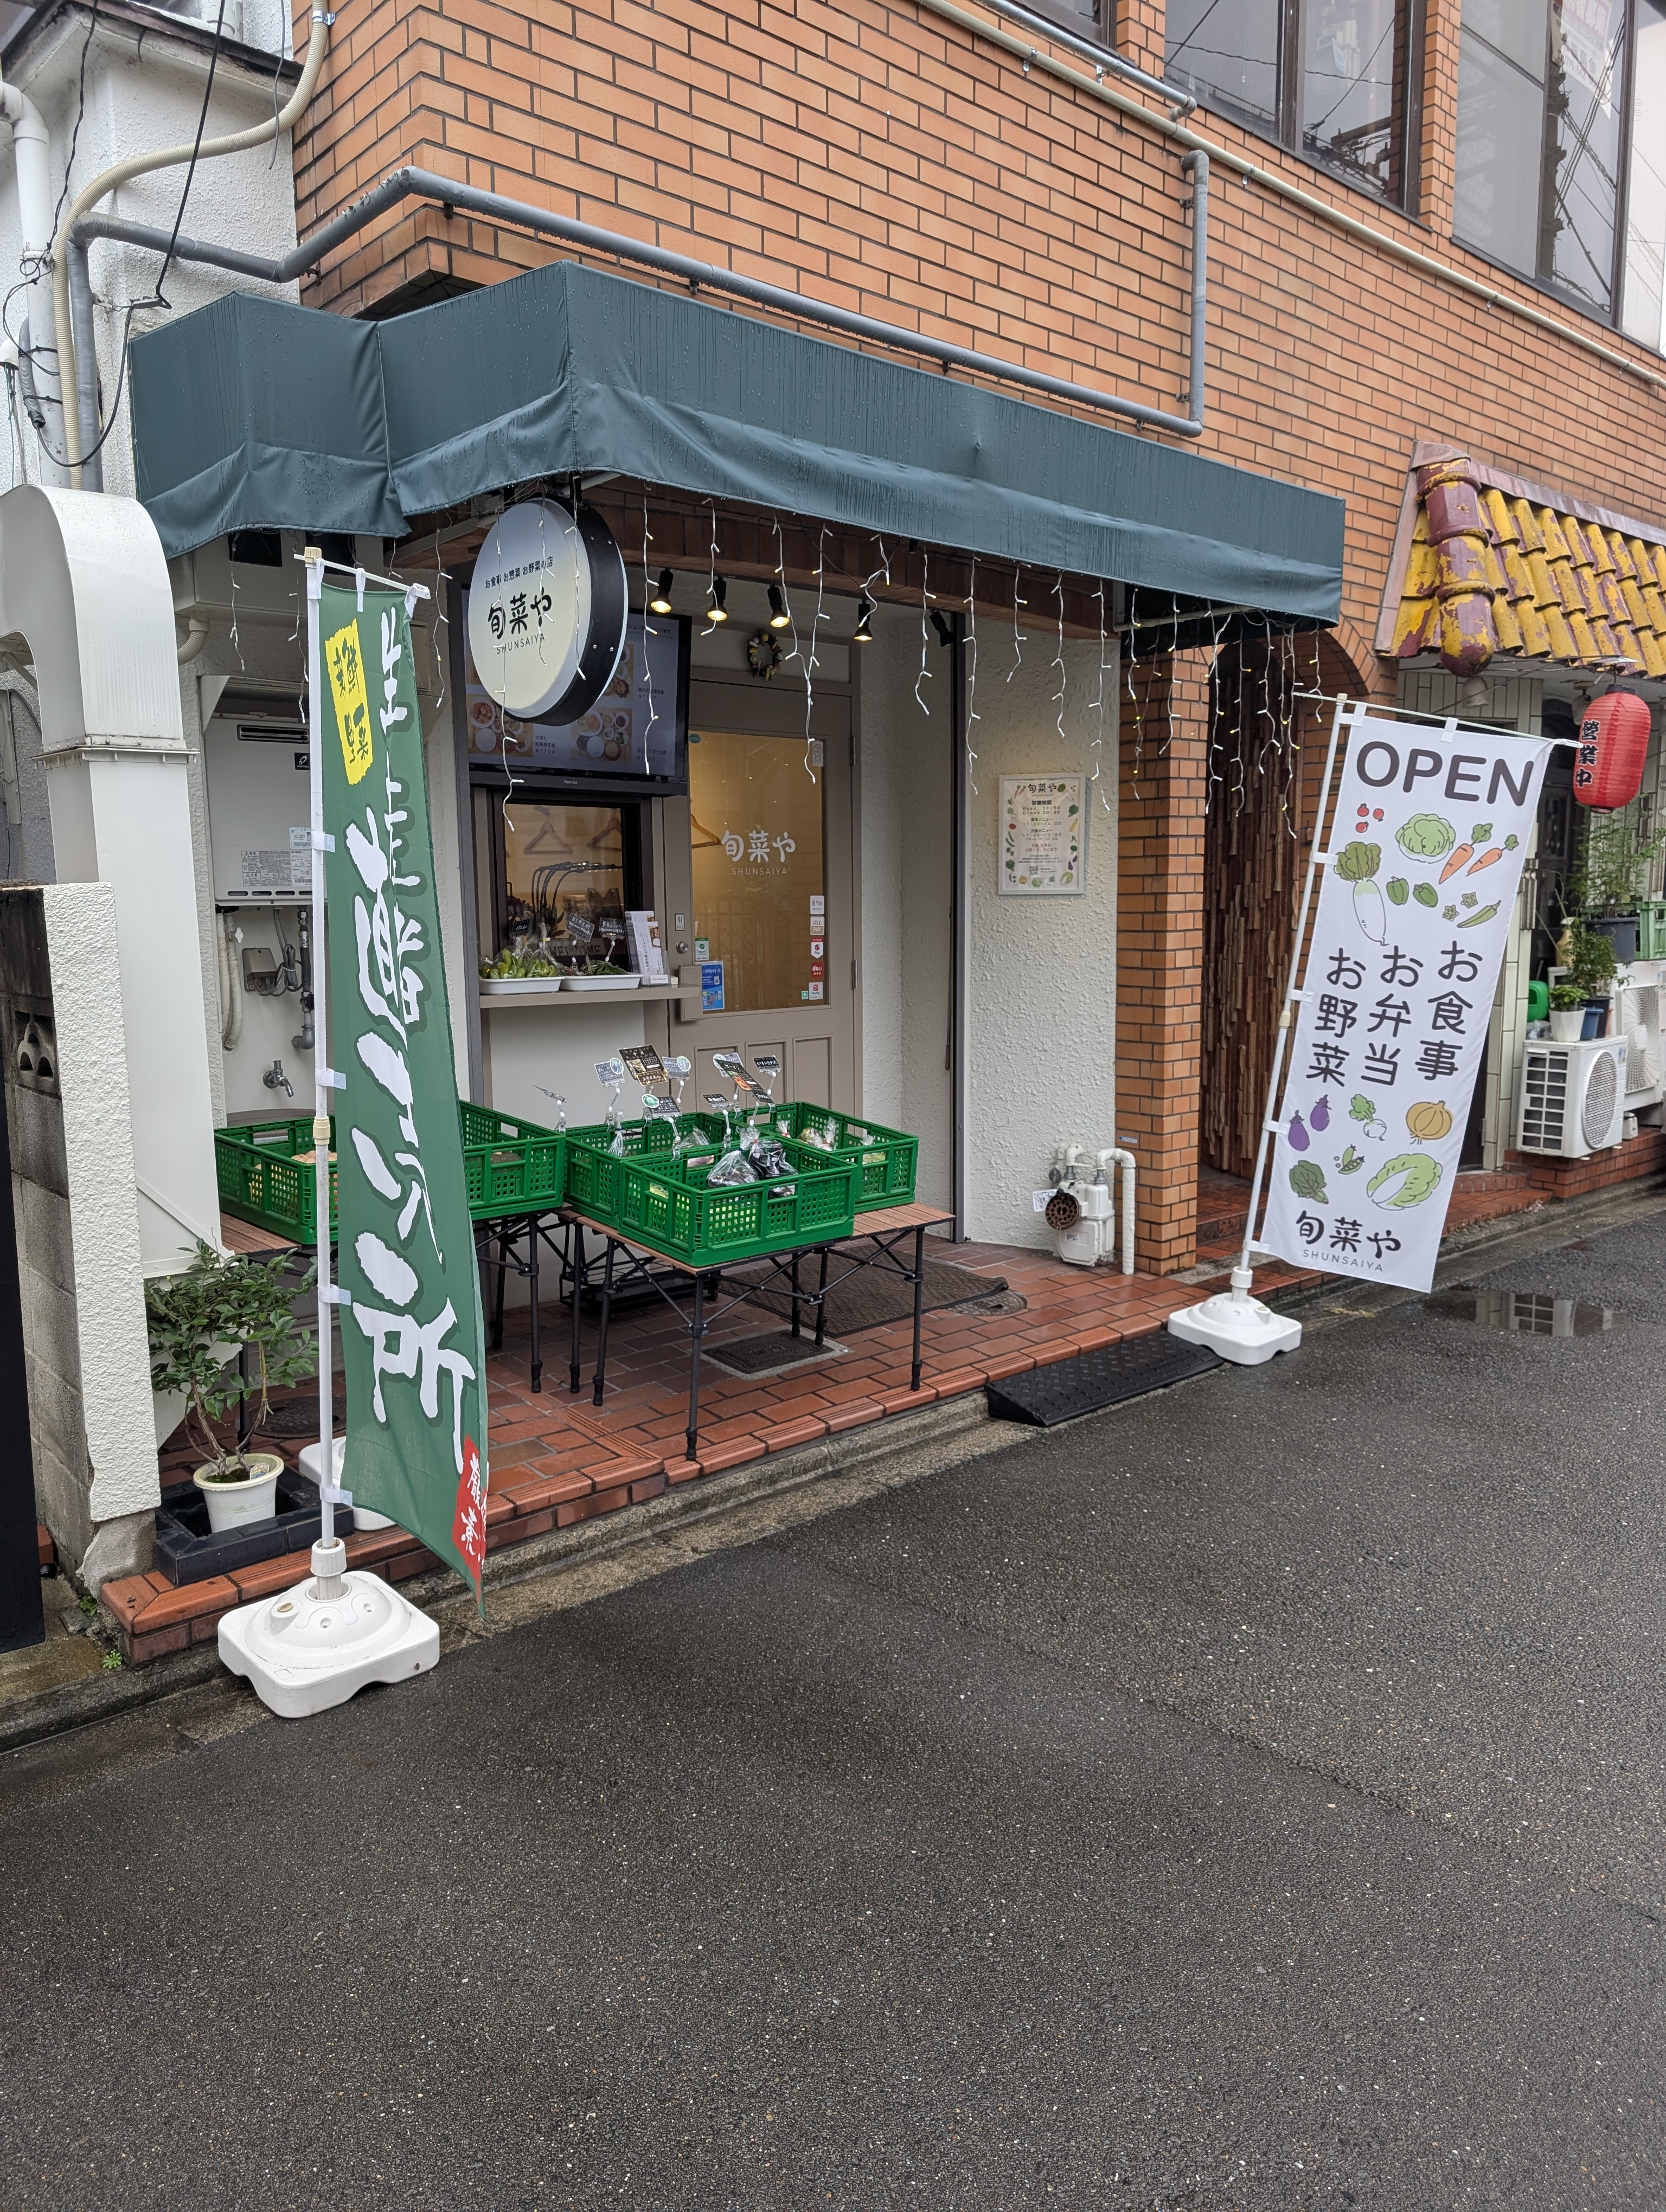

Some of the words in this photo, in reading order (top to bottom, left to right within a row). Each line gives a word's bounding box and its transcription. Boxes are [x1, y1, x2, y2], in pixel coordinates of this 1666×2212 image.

[503, 567, 521, 583] お惣菜
[522, 556, 553, 575] お野菜の店
[488, 586, 552, 640] 旬菜や
[496, 632, 545, 654] SHUNSAIYA
[1028, 783, 1057, 793] 旬菜や
[1356, 741, 1535, 807] OPEN
[721, 829, 797, 863] 旬菜や
[731, 867, 787, 876] SHUNSAIYA
[1305, 948, 1365, 1088] お野菜
[1360, 945, 1424, 1086] お弁当
[1414, 940, 1484, 1082] お食事
[1296, 1210, 1402, 1261] 旬菜や
[1302, 1249, 1385, 1274] SHUNSAIYA
